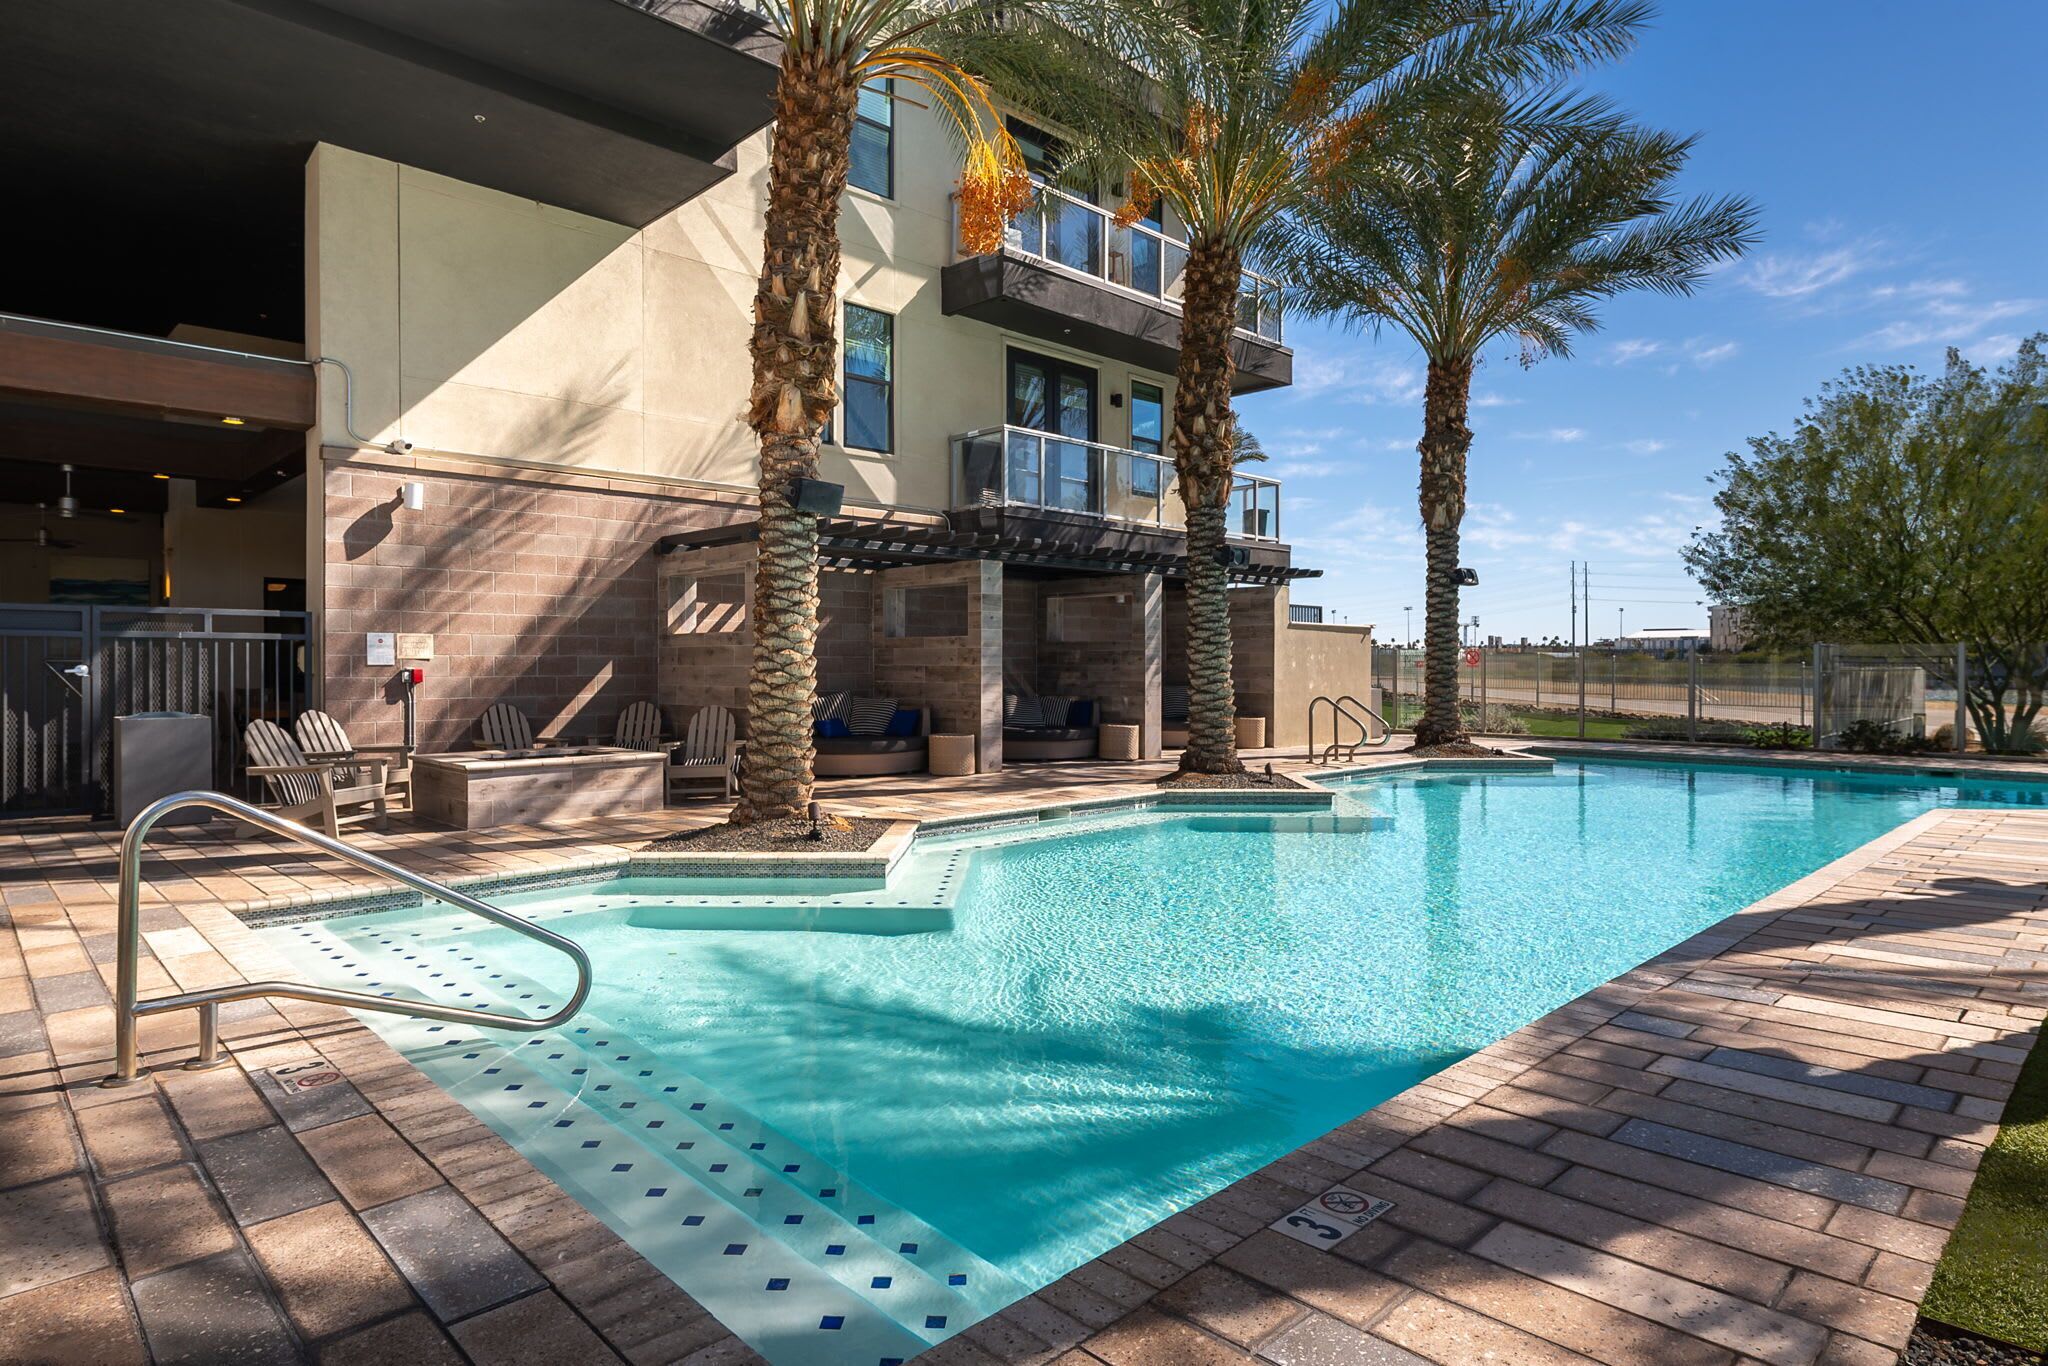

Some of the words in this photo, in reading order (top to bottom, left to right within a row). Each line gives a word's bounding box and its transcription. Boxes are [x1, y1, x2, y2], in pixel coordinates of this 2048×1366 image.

[276, 1061, 325, 1075] 3
[1299, 1208, 1316, 1217] FT
[1354, 1214, 1367, 1225] NO
[1367, 1201, 1390, 1218] DIVING
[1286, 1215, 1343, 1240] 3
